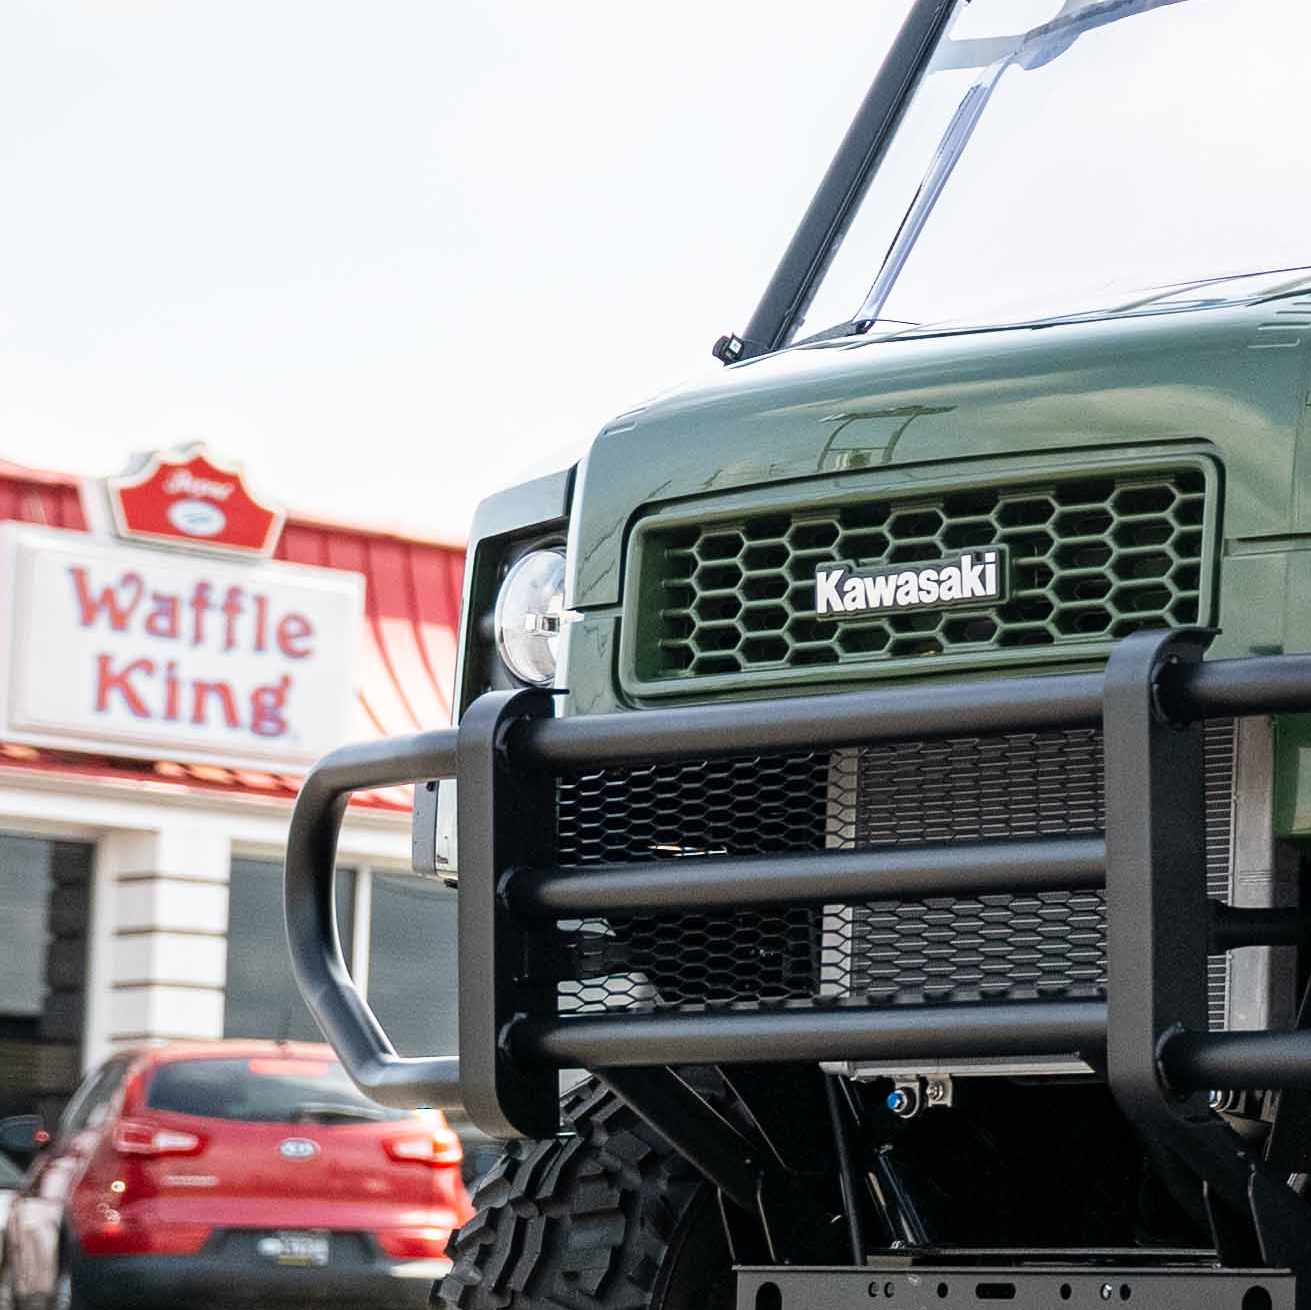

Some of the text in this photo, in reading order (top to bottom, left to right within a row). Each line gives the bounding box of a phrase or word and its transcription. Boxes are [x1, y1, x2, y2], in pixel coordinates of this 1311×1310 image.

[66, 565, 316, 660] Waffle
[816, 551, 997, 614] Kawasaki
[93, 651, 292, 738] King
